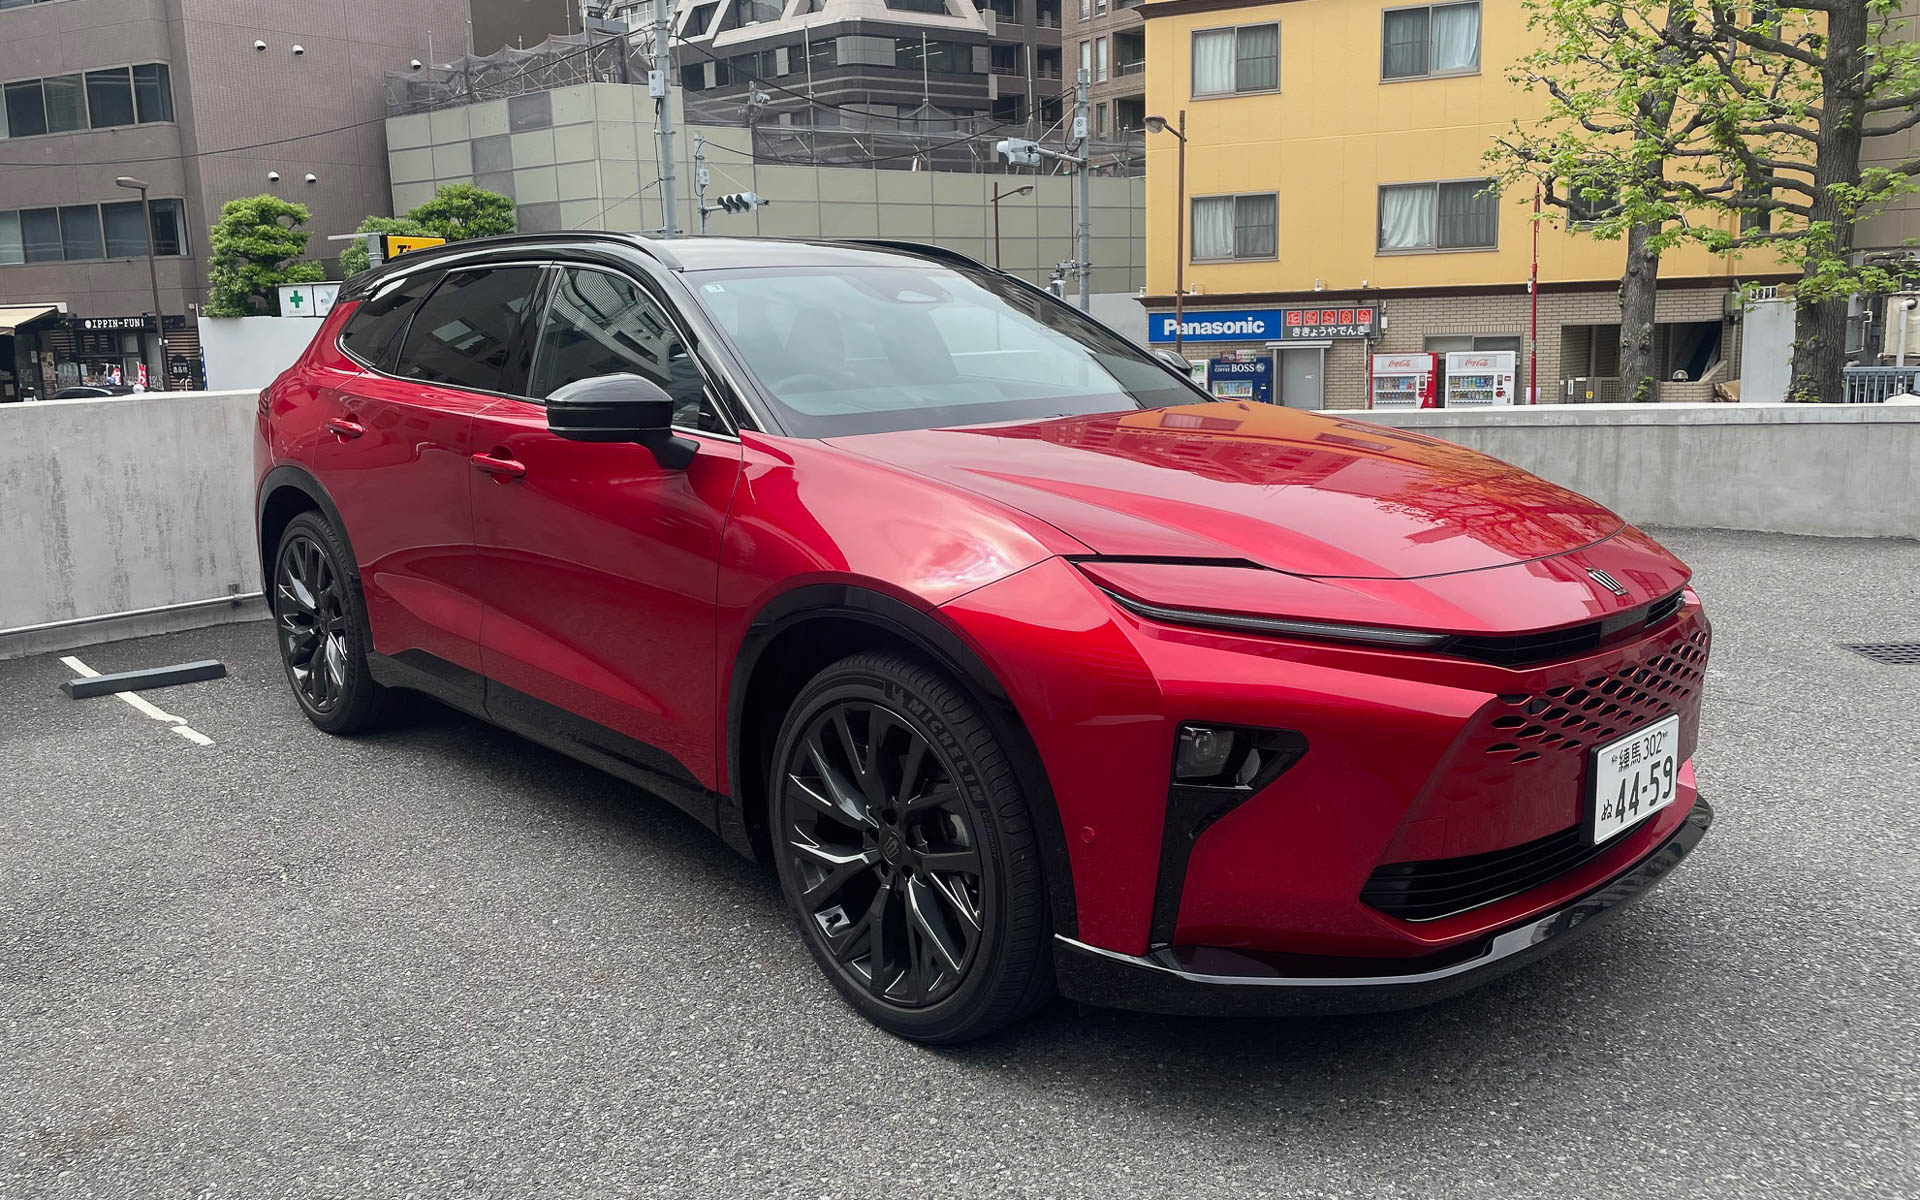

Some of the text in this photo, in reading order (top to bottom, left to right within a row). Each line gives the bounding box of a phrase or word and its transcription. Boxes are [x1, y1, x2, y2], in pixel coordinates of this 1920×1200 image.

[1163, 316, 1265, 336] Panasonic
[1231, 363, 1255, 373] BOSS
[907, 699, 985, 801] MICHELIN
[1618, 731, 1663, 773] 練馬 302
[1615, 755, 1674, 824] 44-59
